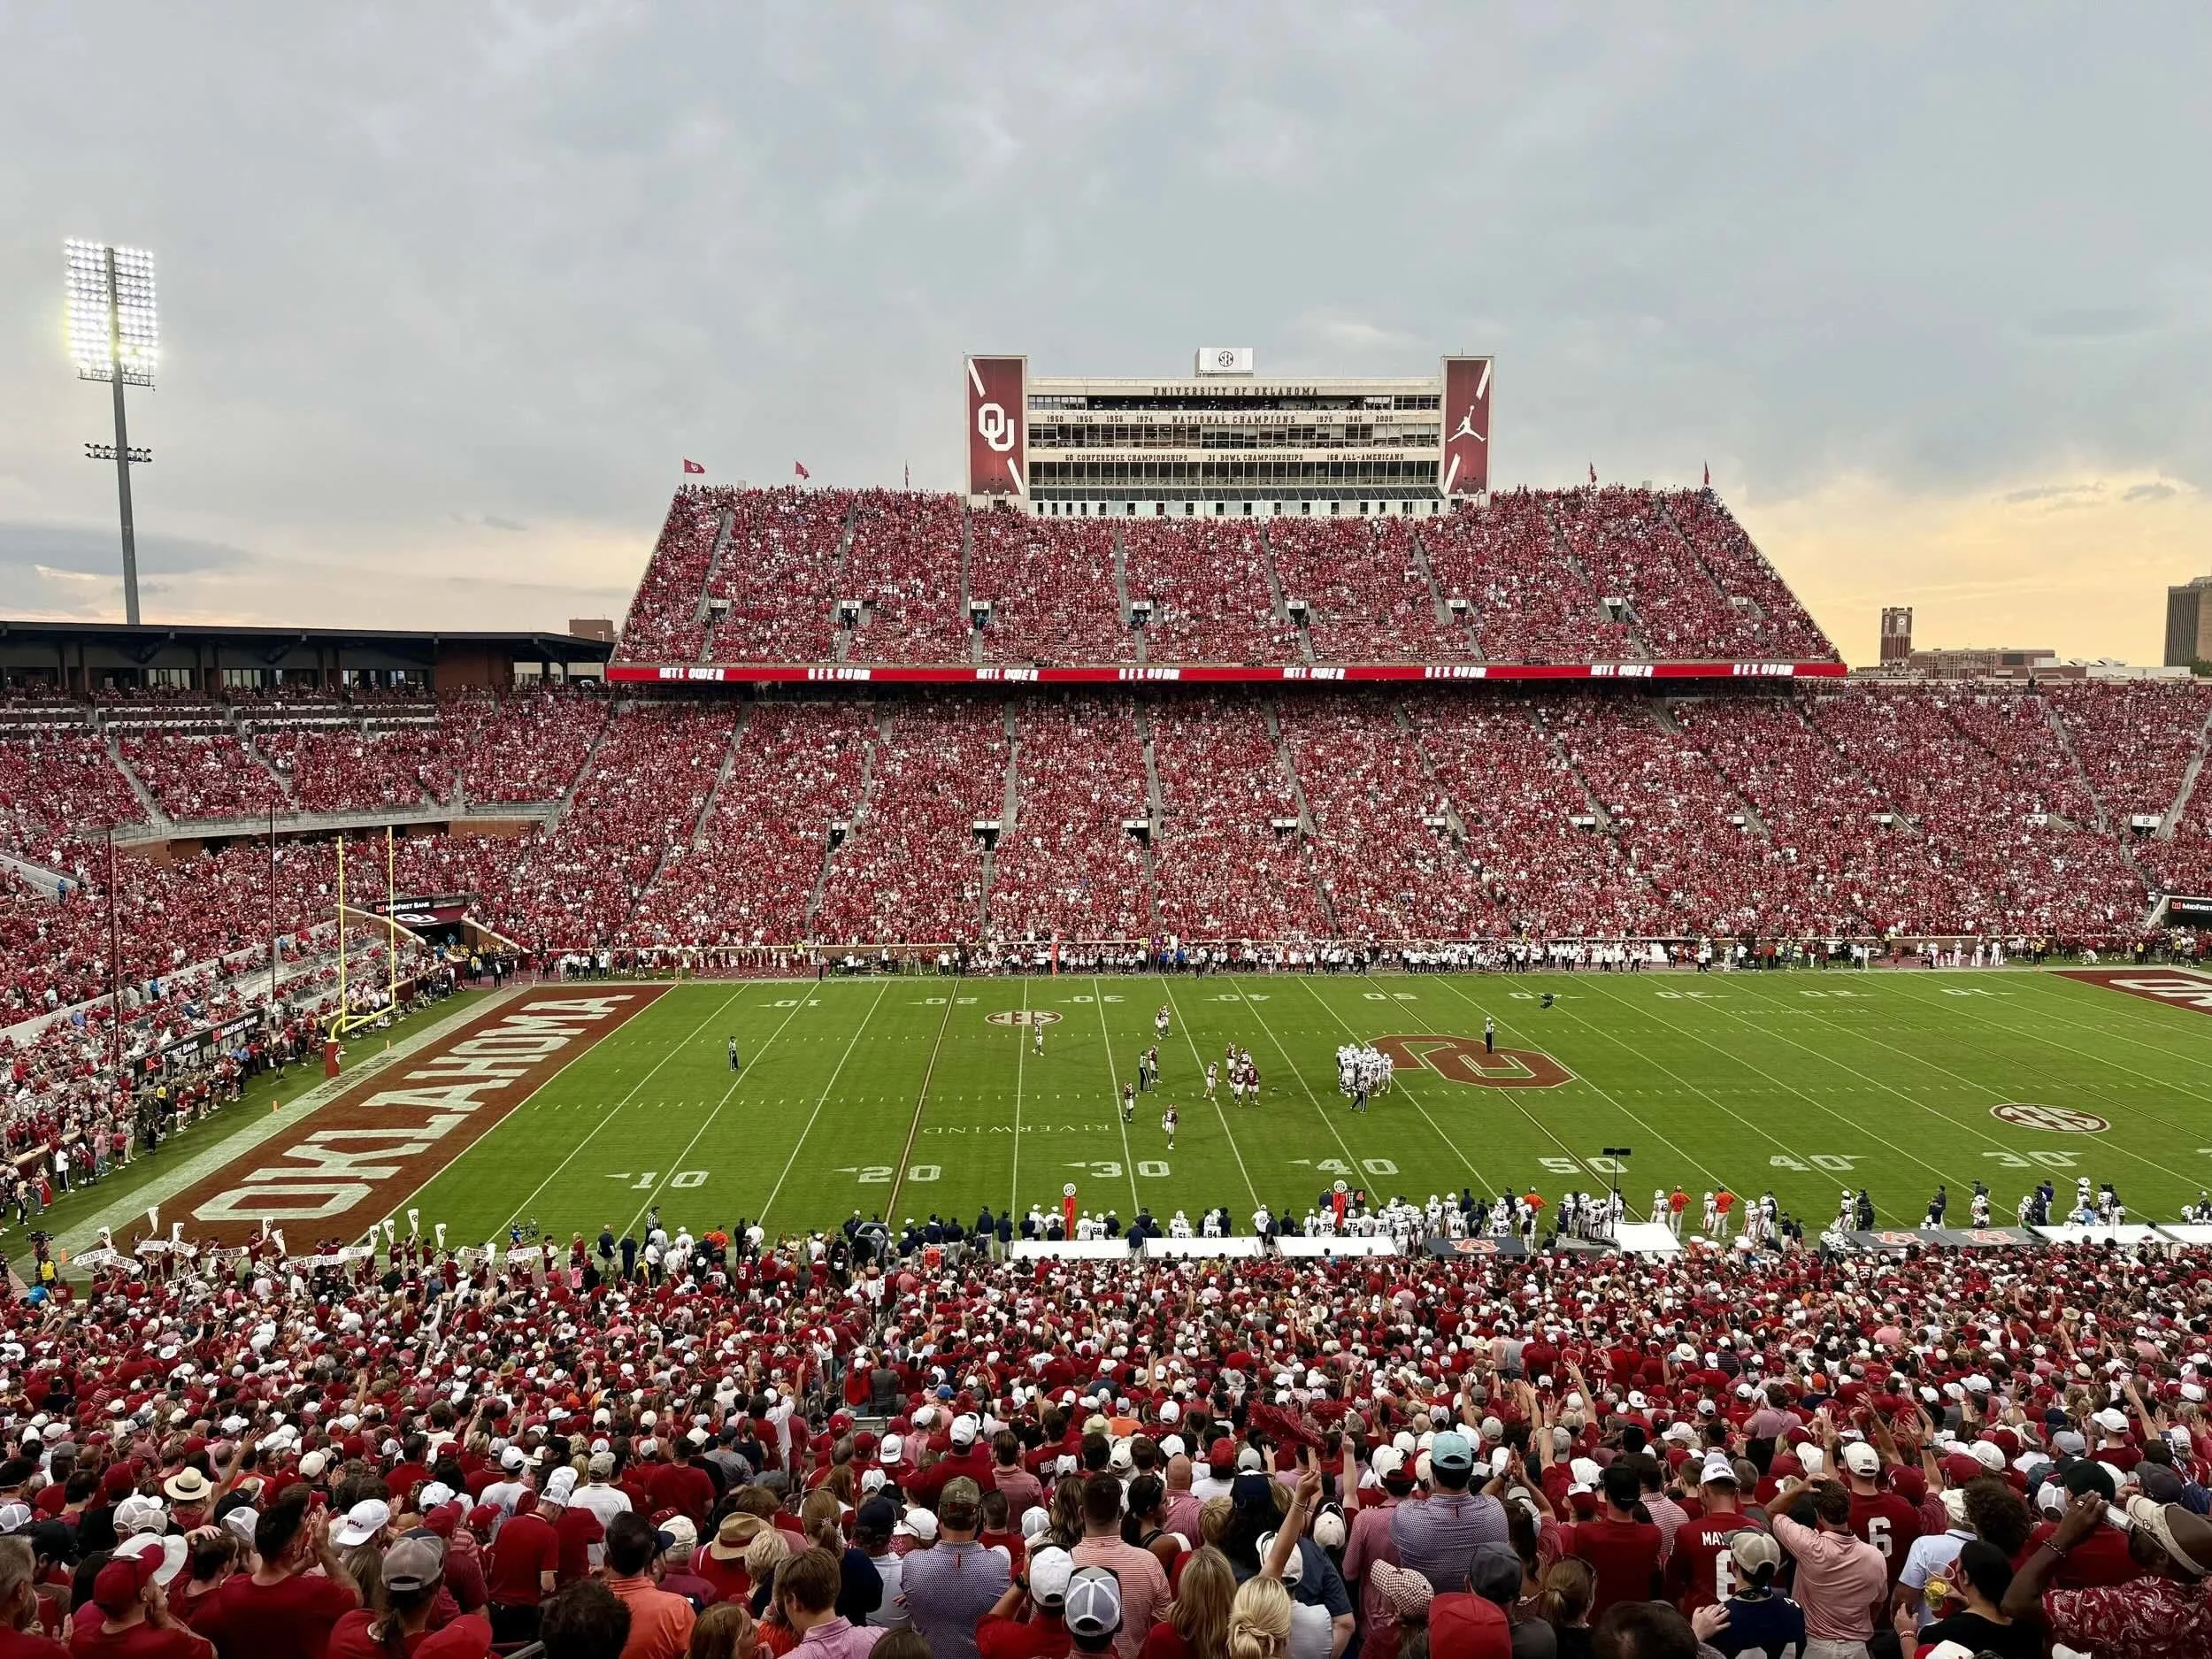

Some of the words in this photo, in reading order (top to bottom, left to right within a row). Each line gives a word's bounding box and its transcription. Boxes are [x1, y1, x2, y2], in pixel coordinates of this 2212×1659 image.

[1218, 351, 1233, 367] SEC
[1153, 387, 1227, 396] UNIVERSITY
[1234, 387, 1248, 396] OF
[1254, 387, 1318, 396] OKLAHOMA
[978, 403, 1015, 452] OU
[1171, 415, 1226, 424] NATIONAL
[1233, 415, 1296, 424] CHAMPIONS
[245, 1016, 258, 1028] BANK
[986, 1010, 1064, 1026] SEC
[183, 1041, 199, 1054] BANK
[1363, 1033, 1578, 1089] OU
[192, 995, 636, 1222] OKLAHOMA
[1989, 1103, 2112, 1133] SEC
[924, 1124, 1111, 1134] RIVERWIND
[1316, 1158, 1400, 1175] 40
[1538, 1157, 1629, 1173] 50
[1770, 1155, 1855, 1171] 40
[1981, 1151, 2078, 1167] 30
[857, 1165, 941, 1184] 20
[1089, 1161, 1171, 1178] 30
[630, 1171, 710, 1189] 10
[1356, 1191, 1364, 1201] 4
[79, 1252, 100, 1264] STAND
[211, 1248, 231, 1257] STAND
[510, 1250, 527, 1259] STAND
[286, 1260, 303, 1272] STAND
[1868, 1516, 1893, 1558] 6
